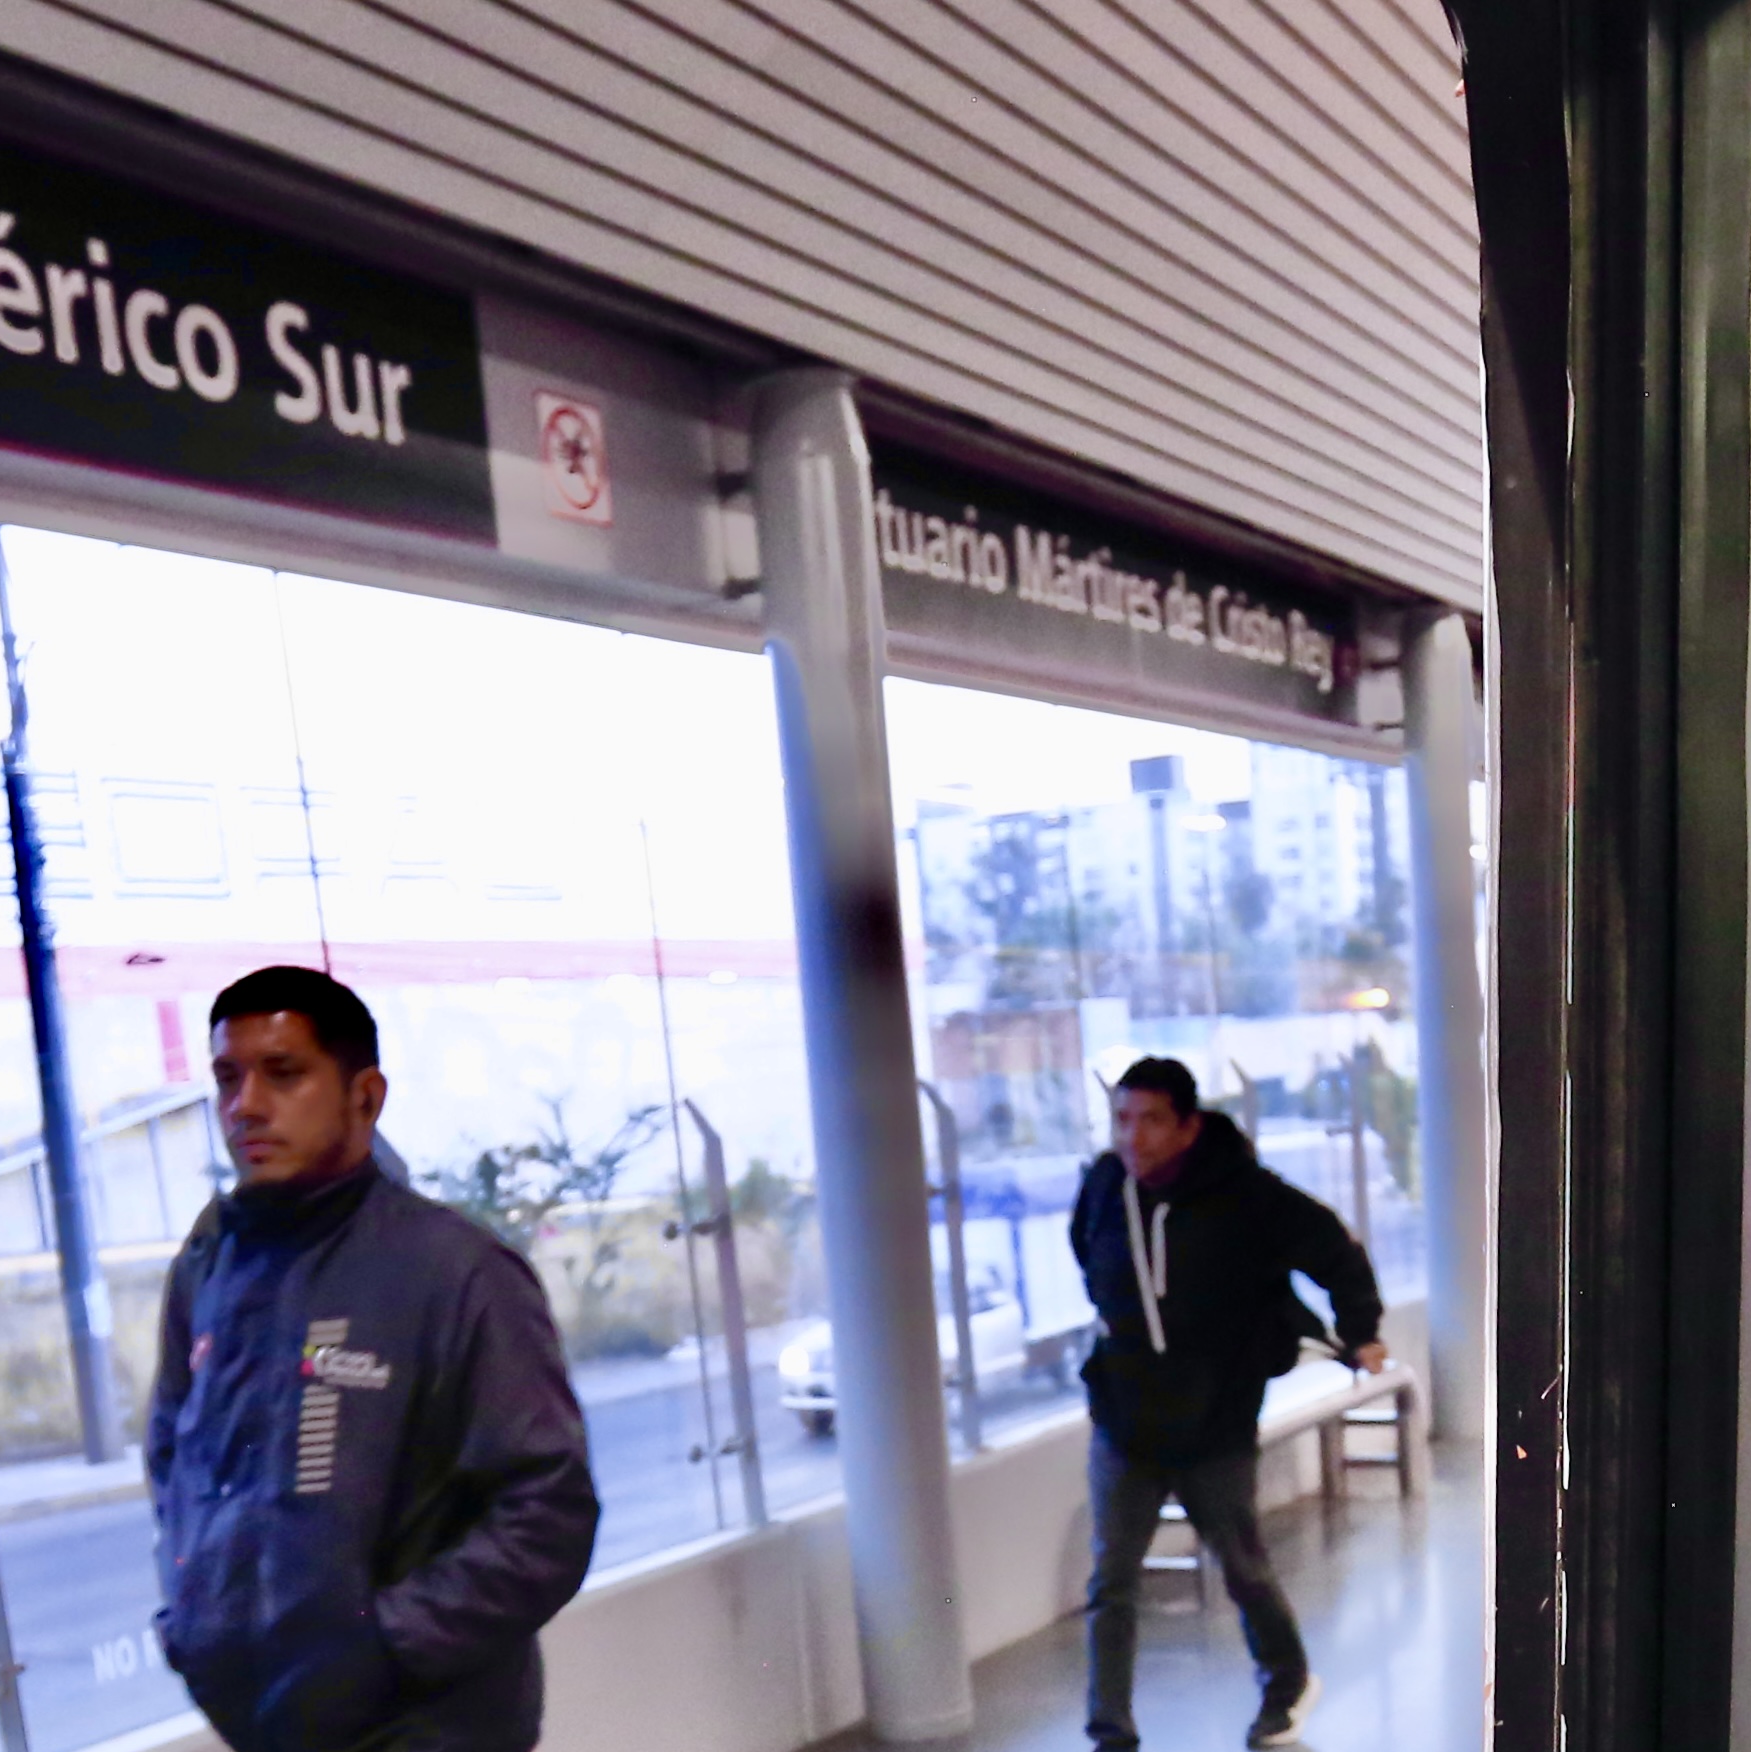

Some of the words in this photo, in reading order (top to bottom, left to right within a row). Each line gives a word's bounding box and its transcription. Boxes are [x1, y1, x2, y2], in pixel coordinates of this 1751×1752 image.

[264, 300, 414, 447] Sur
[874, 488, 1008, 595] tuario
[1014, 523, 1161, 634] Mártires
[1164, 571, 1206, 646] de
[1208, 584, 1287, 666] Cristo
[1288, 608, 1334, 695] Rey
